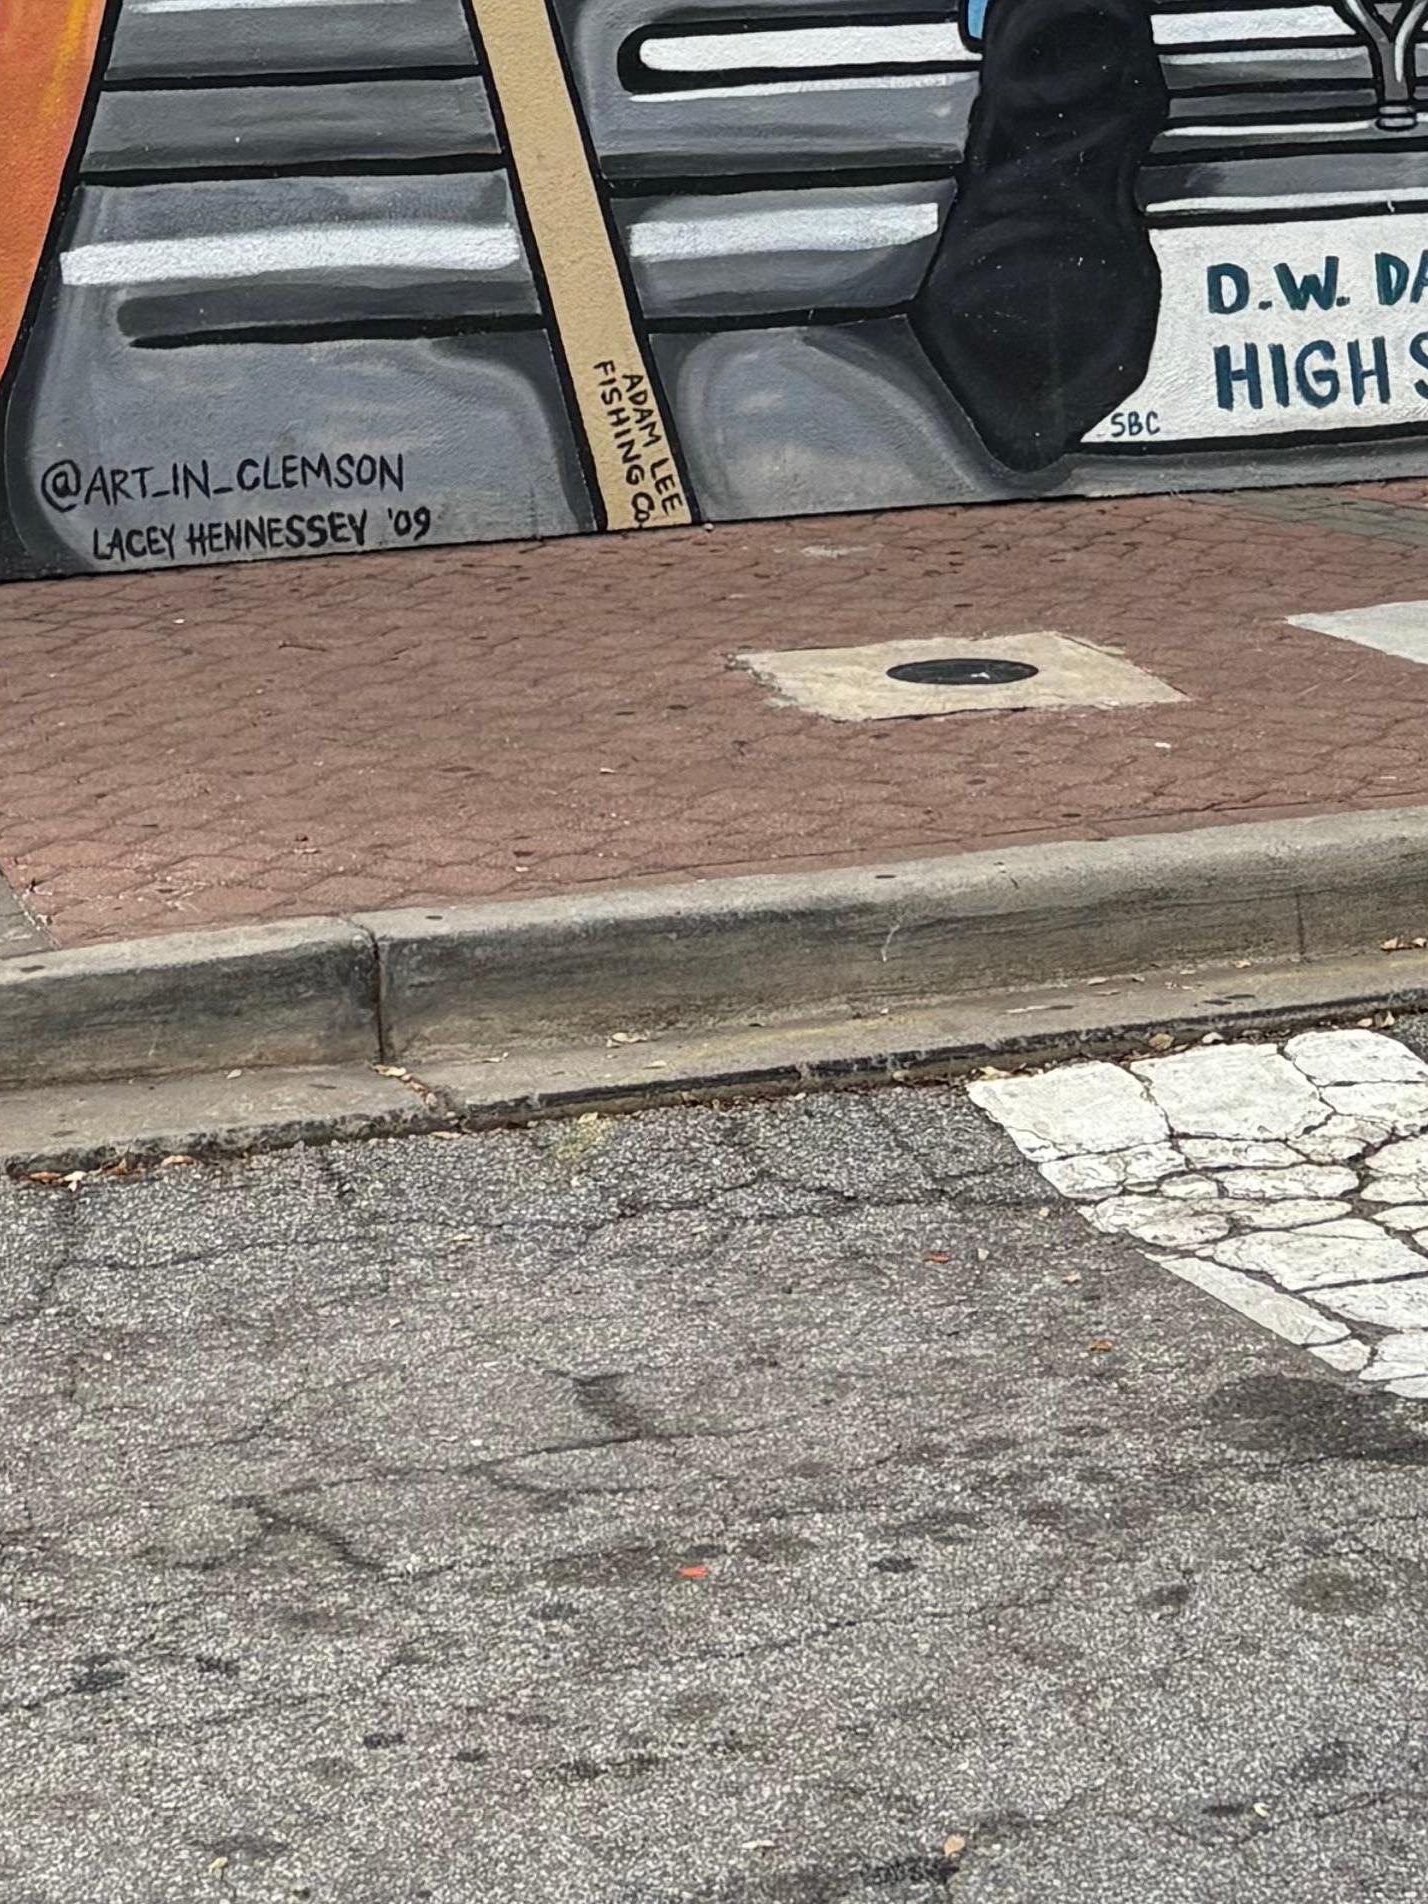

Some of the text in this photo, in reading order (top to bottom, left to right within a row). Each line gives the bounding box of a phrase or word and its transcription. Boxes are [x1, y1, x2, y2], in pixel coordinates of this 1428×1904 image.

[1207, 256, 1350, 316] D.W.
[1213, 335, 1391, 412] HIGH
[593, 360, 645, 486] FISHING
[622, 374, 684, 517] ADAM LEE
[1110, 411, 1161, 438] SBC
[40, 452, 405, 513] @ART_IN_CLEMSON
[92, 523, 176, 562] LACEY
[186, 510, 369, 554] HENNESSEY
